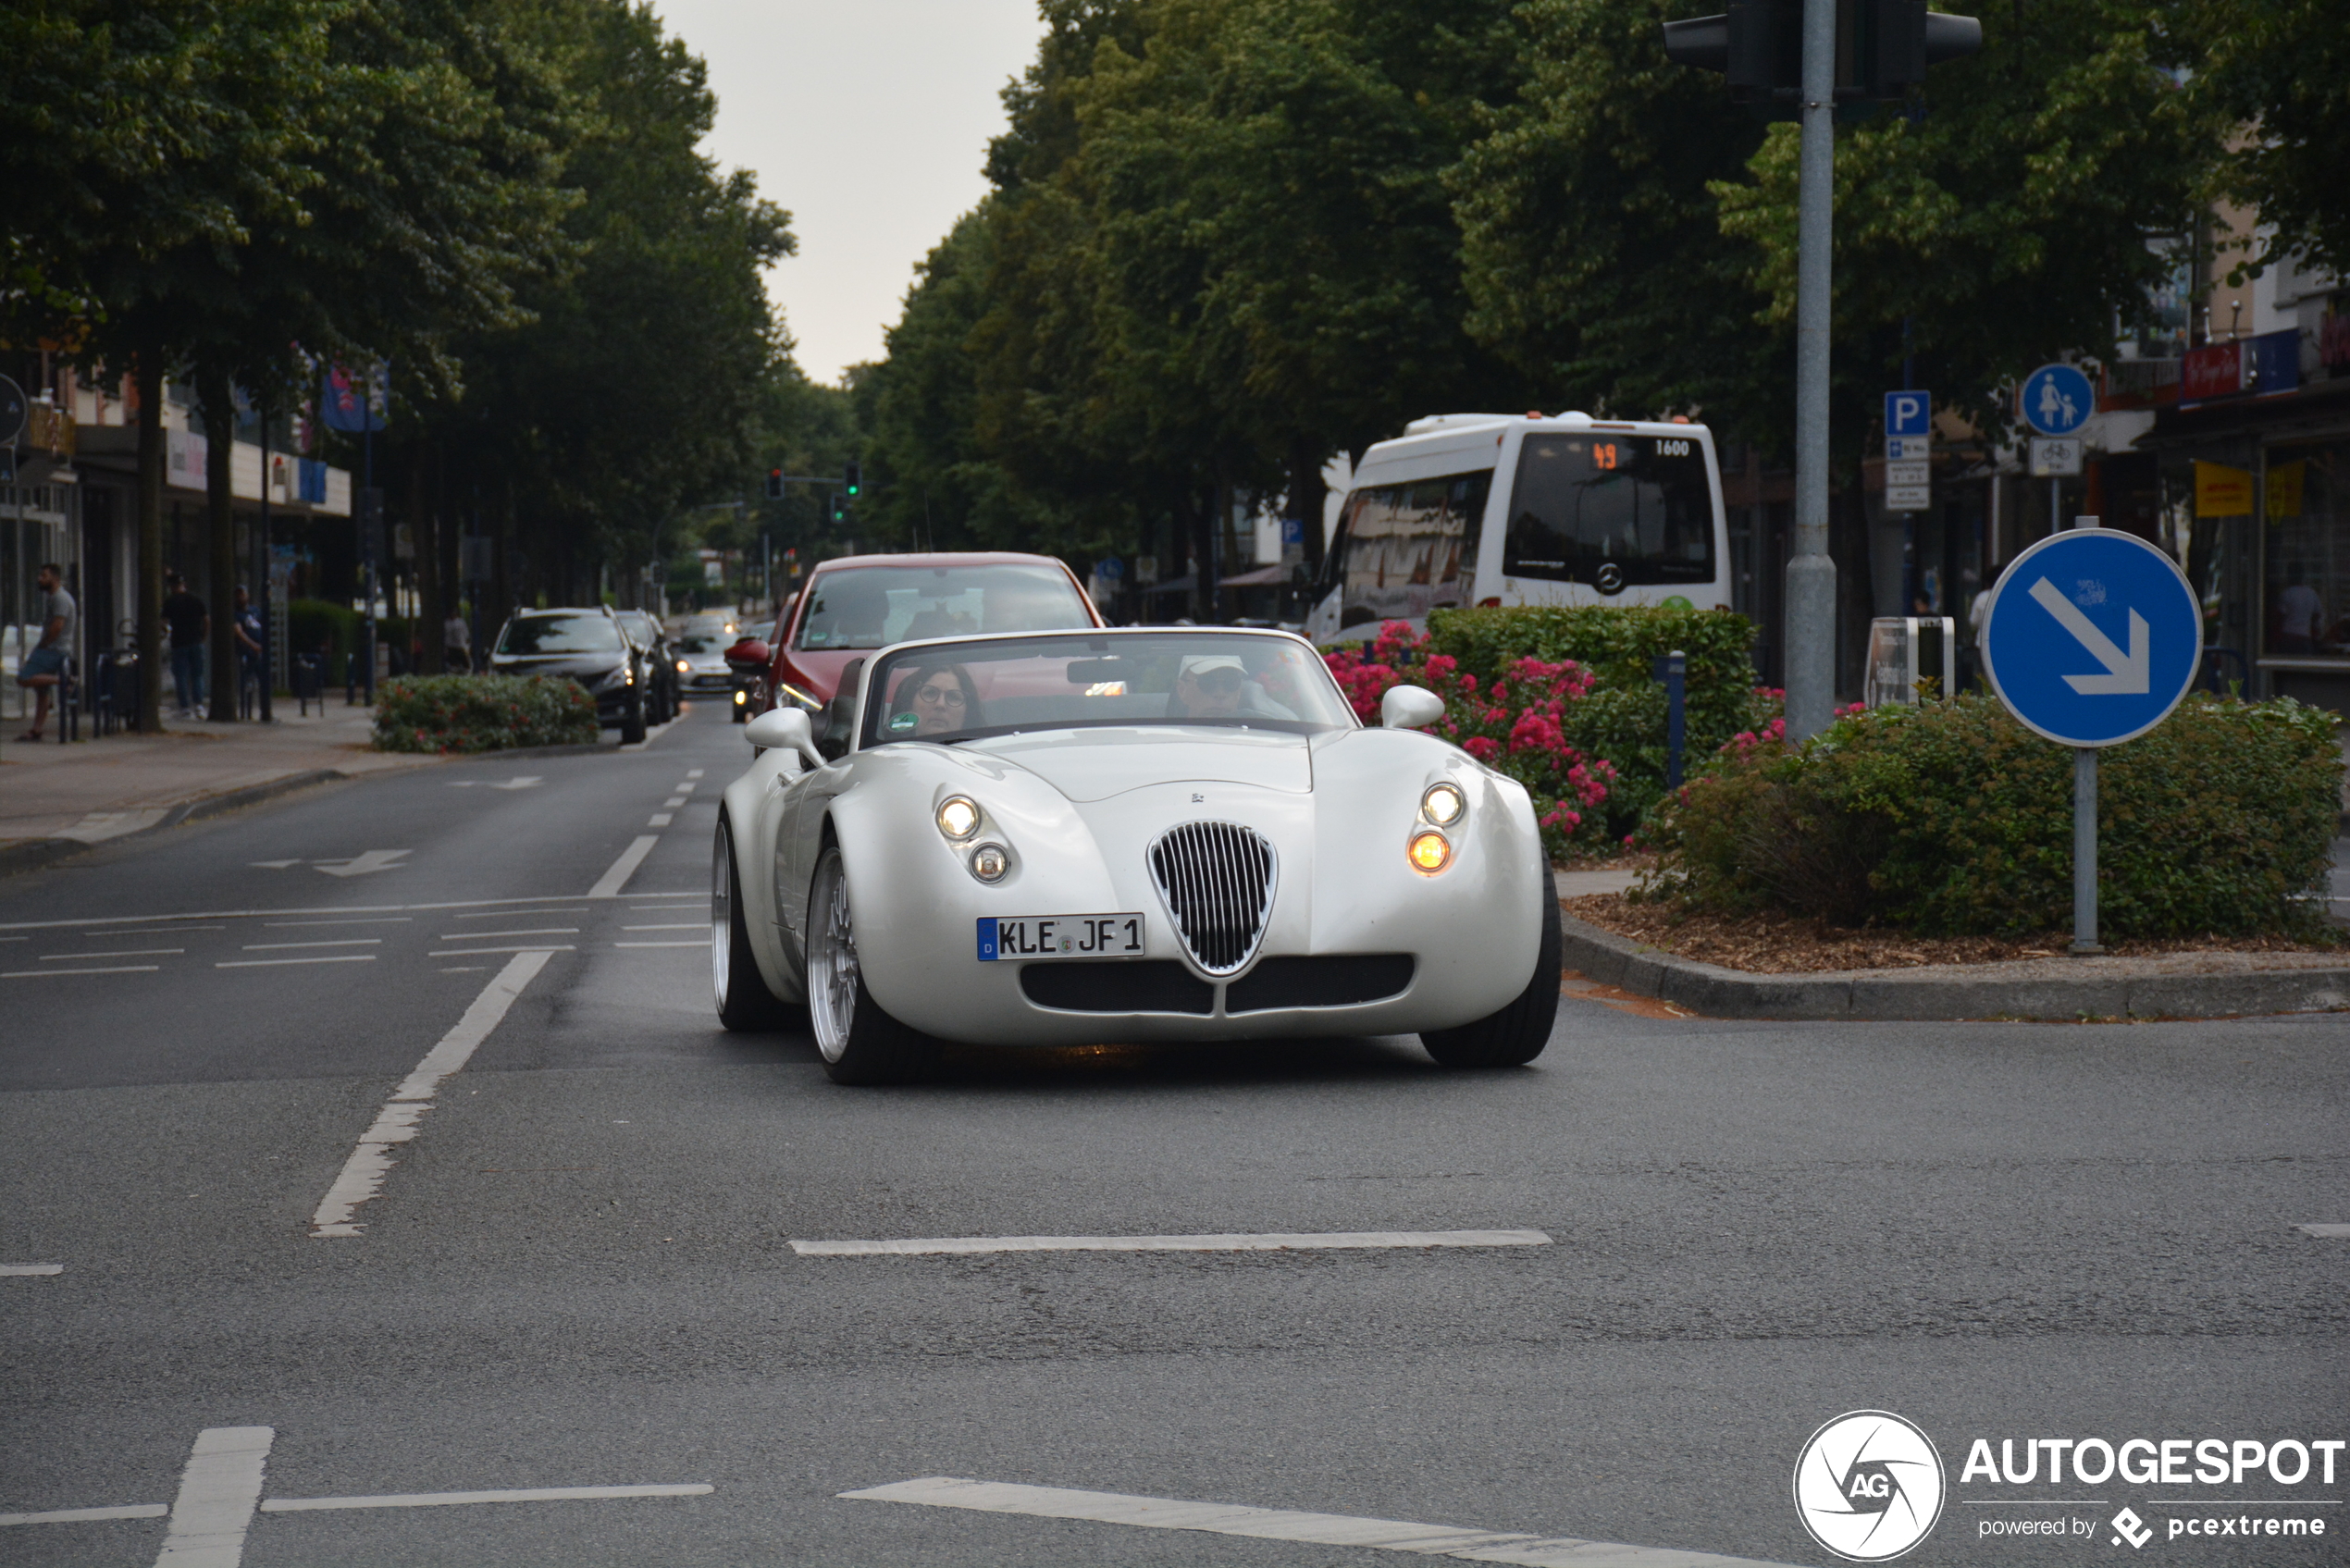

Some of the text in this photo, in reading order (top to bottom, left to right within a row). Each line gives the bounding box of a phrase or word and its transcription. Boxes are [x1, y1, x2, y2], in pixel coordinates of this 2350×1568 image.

[1896, 397, 1920, 431] P
[1593, 443, 1616, 470] 49
[1656, 439, 1689, 456] 1600
[1285, 522, 1298, 542] P
[998, 919, 1141, 954] KLE JF 1
[984, 944, 993, 953] D
